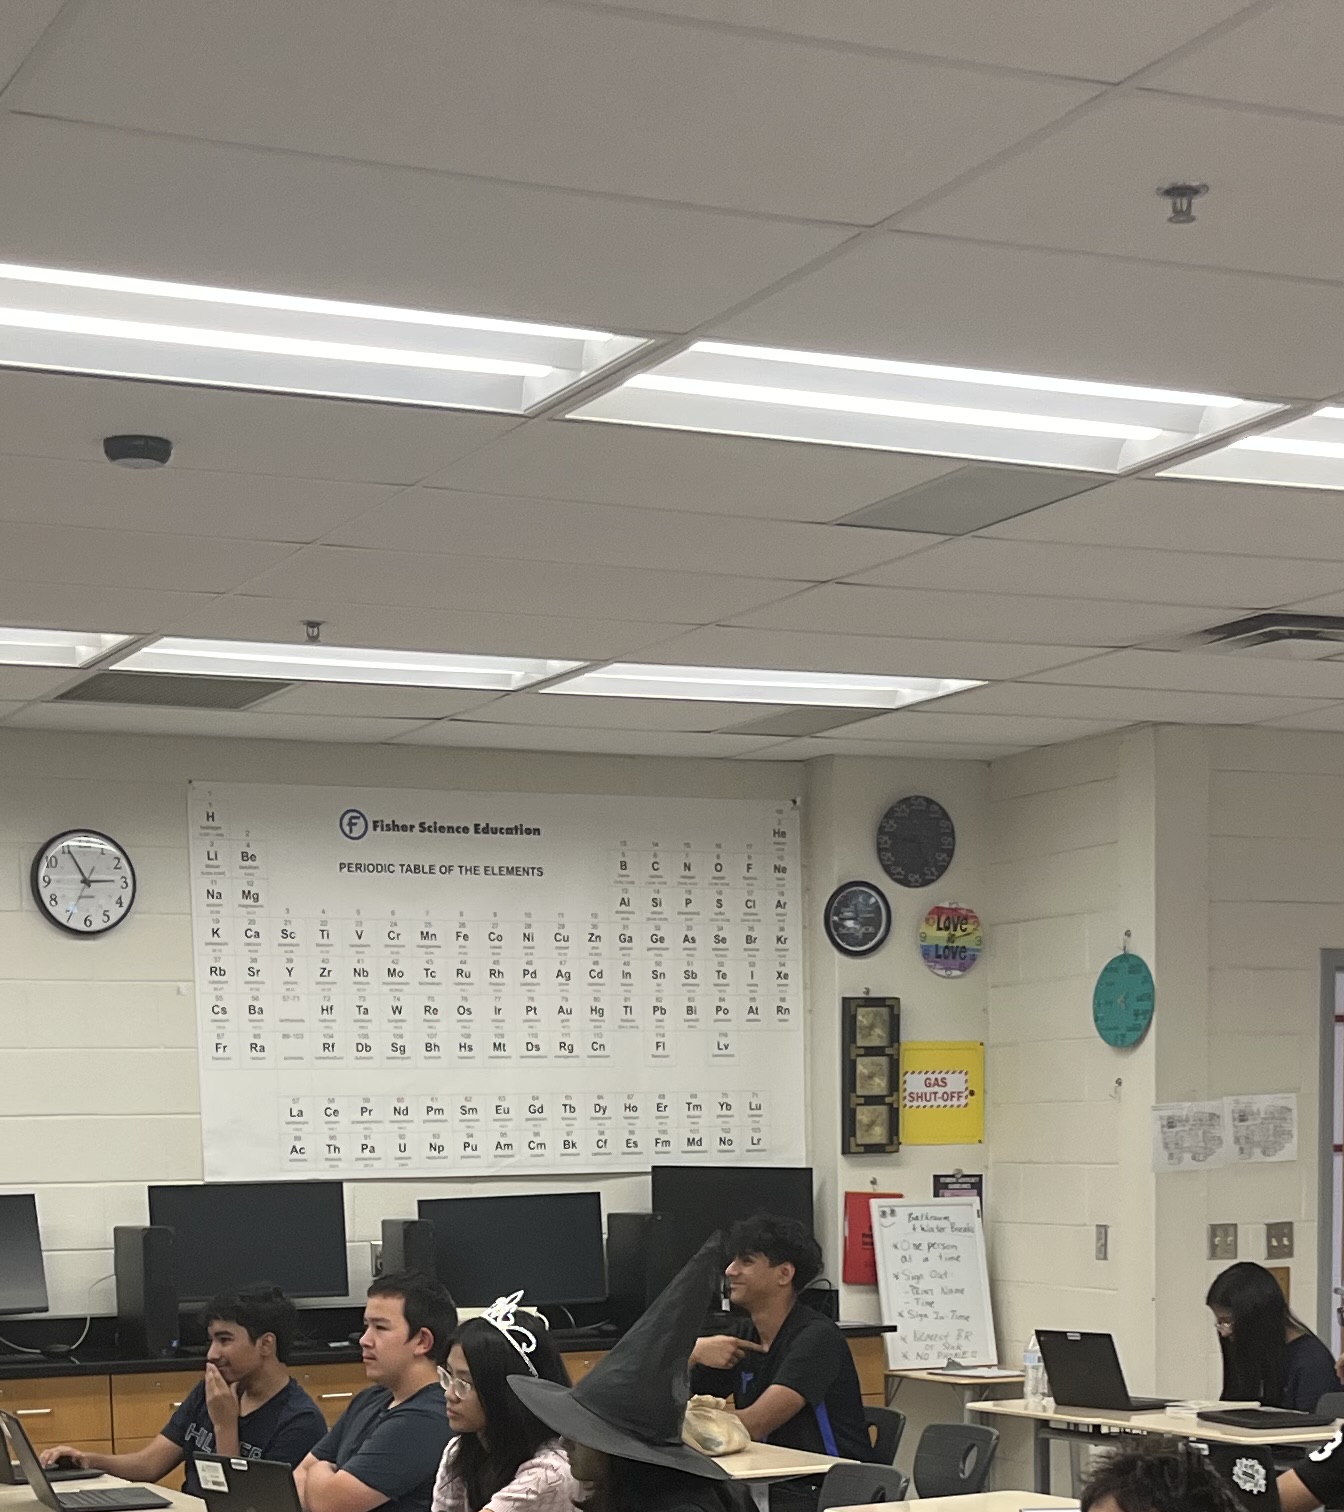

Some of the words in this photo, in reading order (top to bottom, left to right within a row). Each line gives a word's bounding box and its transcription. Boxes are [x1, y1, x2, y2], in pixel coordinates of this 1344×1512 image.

[205, 811, 215, 823] H
[372, 820, 416, 833] Fisher
[419, 821, 469, 834] Science
[474, 823, 541, 836] Education
[772, 828, 787, 839] He
[45, 855, 58, 868] 10
[113, 857, 122, 870] 2
[206, 850, 218, 861] Li
[240, 850, 257, 862] Be
[338, 862, 395, 874] PERIODIC
[399, 863, 436, 875] TABLE
[439, 864, 454, 875] OF
[458, 865, 481, 876] THE
[484, 866, 544, 877] ELEMENTS
[619, 860, 628, 871] B
[651, 860, 660, 872] C
[683, 861, 692, 872] N
[714, 862, 723, 873] O
[746, 862, 753, 874] F
[773, 863, 788, 875] Ne
[42, 875, 51, 888] 9
[120, 876, 129, 889] 3
[49, 893, 58, 907] 8
[115, 895, 124, 908] 4
[206, 888, 223, 900] Na
[241, 889, 260, 904] Mg
[619, 896, 631, 908] Al
[651, 897, 662, 908] Si
[685, 897, 693, 908] P
[715, 898, 724, 909] S
[744, 898, 756, 910] Cl
[775, 899, 787, 910] Ar
[83, 915, 93, 928] 6
[102, 910, 110, 923] 5
[211, 927, 221, 939] K
[244, 928, 261, 939] Ca
[280, 928, 296, 940] Sc
[318, 929, 330, 940] Ti
[355, 929, 364, 940] V
[387, 930, 401, 941] Cr
[420, 930, 437, 941] Mn
[455, 931, 469, 942] Fe
[487, 931, 503, 943] Co
[522, 932, 534, 943] Ni
[553, 932, 570, 943] Cu
[587, 932, 602, 943] Zn
[618, 933, 633, 944] Ga
[650, 933, 665, 944] Ge
[682, 933, 697, 944] As
[713, 934, 727, 945] Se
[745, 934, 758, 945] Br
[775, 934, 789, 945] Kr
[209, 966, 227, 977] Rb
[247, 966, 261, 977] Sr
[285, 966, 295, 978] Y
[319, 967, 333, 978] Zr
[353, 967, 369, 978] Nb
[387, 967, 405, 979] Mo
[423, 967, 437, 979] Tc
[456, 968, 471, 979] Ru
[489, 968, 504, 979] Rh
[522, 968, 537, 979] Pd
[555, 968, 571, 982] Ag
[588, 968, 604, 980] Cd
[621, 969, 632, 980] In
[651, 969, 666, 980] Sn
[683, 969, 698, 980] Sb
[715, 969, 728, 980] Te
[776, 970, 789, 981] Xe
[924, 1077, 948, 1088] GAS
[908, 1091, 964, 1102] SHUT-OFF
[289, 1107, 304, 1118] La
[324, 1106, 340, 1118] Ce
[360, 1106, 374, 1117] Pr
[393, 1106, 409, 1116] Nd
[426, 1105, 445, 1116] Pm
[459, 1105, 478, 1116] Sm
[495, 1104, 510, 1115] Eu
[528, 1103, 544, 1115] Gd
[561, 1103, 576, 1114] Tb
[593, 1103, 608, 1116] Dy
[623, 1102, 638, 1113] Ho
[656, 1102, 668, 1113] Er
[685, 1101, 702, 1112] Tm
[717, 1101, 732, 1112] Yb
[748, 1100, 762, 1111] Lu
[927, 1241, 958, 1253] person
